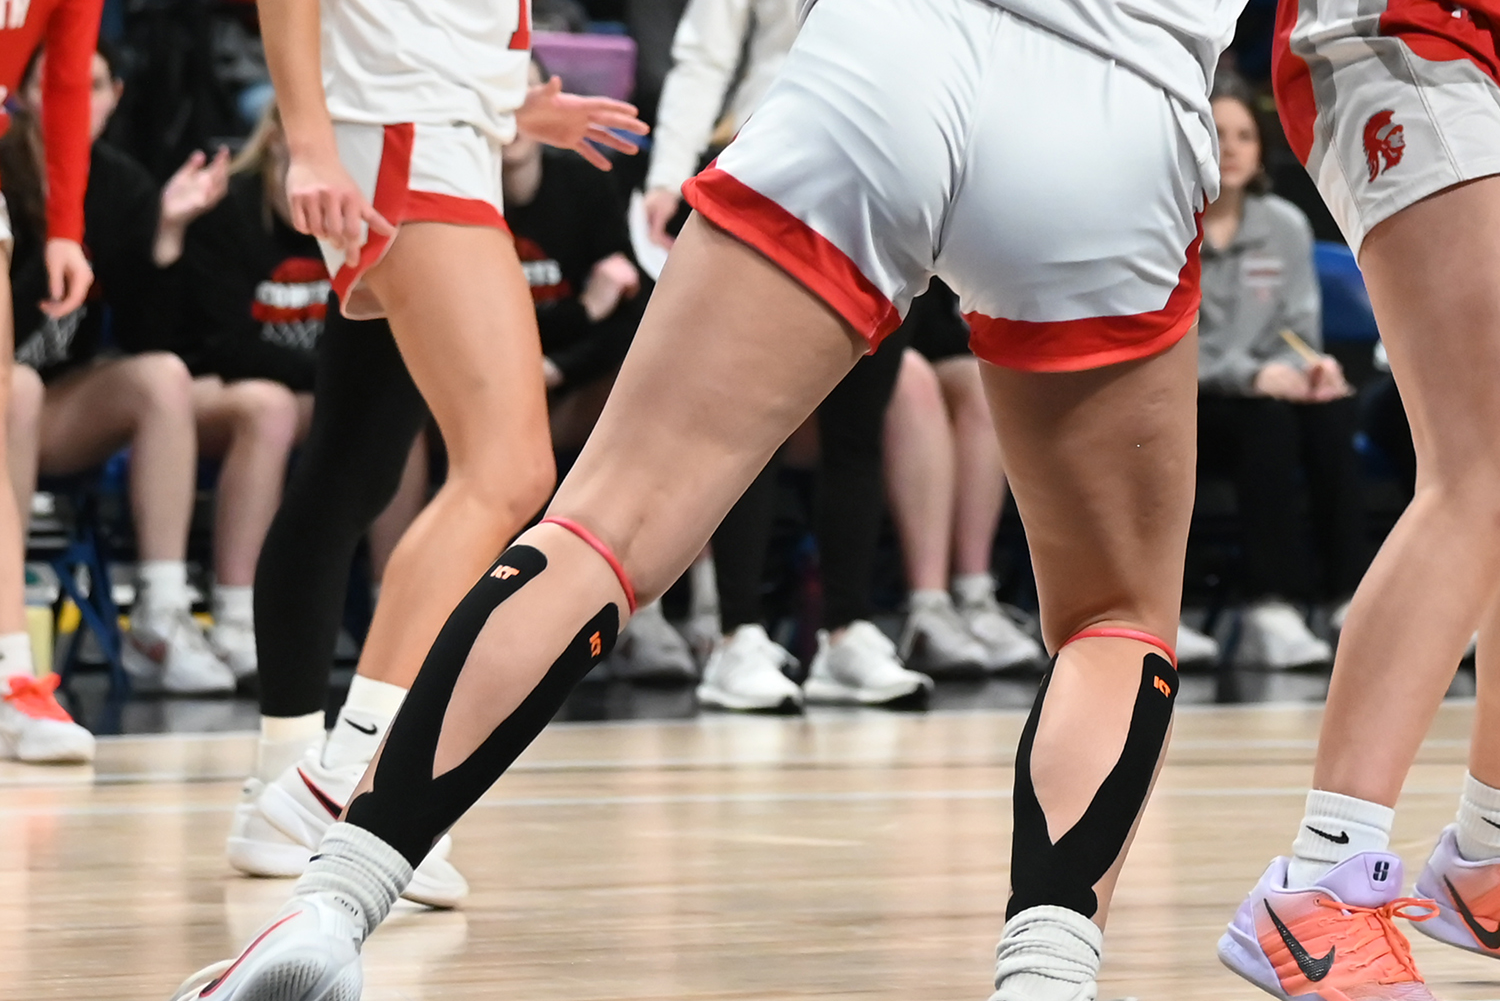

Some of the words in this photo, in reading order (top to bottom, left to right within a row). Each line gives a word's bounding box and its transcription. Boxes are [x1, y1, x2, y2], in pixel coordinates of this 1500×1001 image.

[490, 564, 521, 580] KT
[588, 630, 602, 659] KT
[1153, 675, 1172, 699] KT
